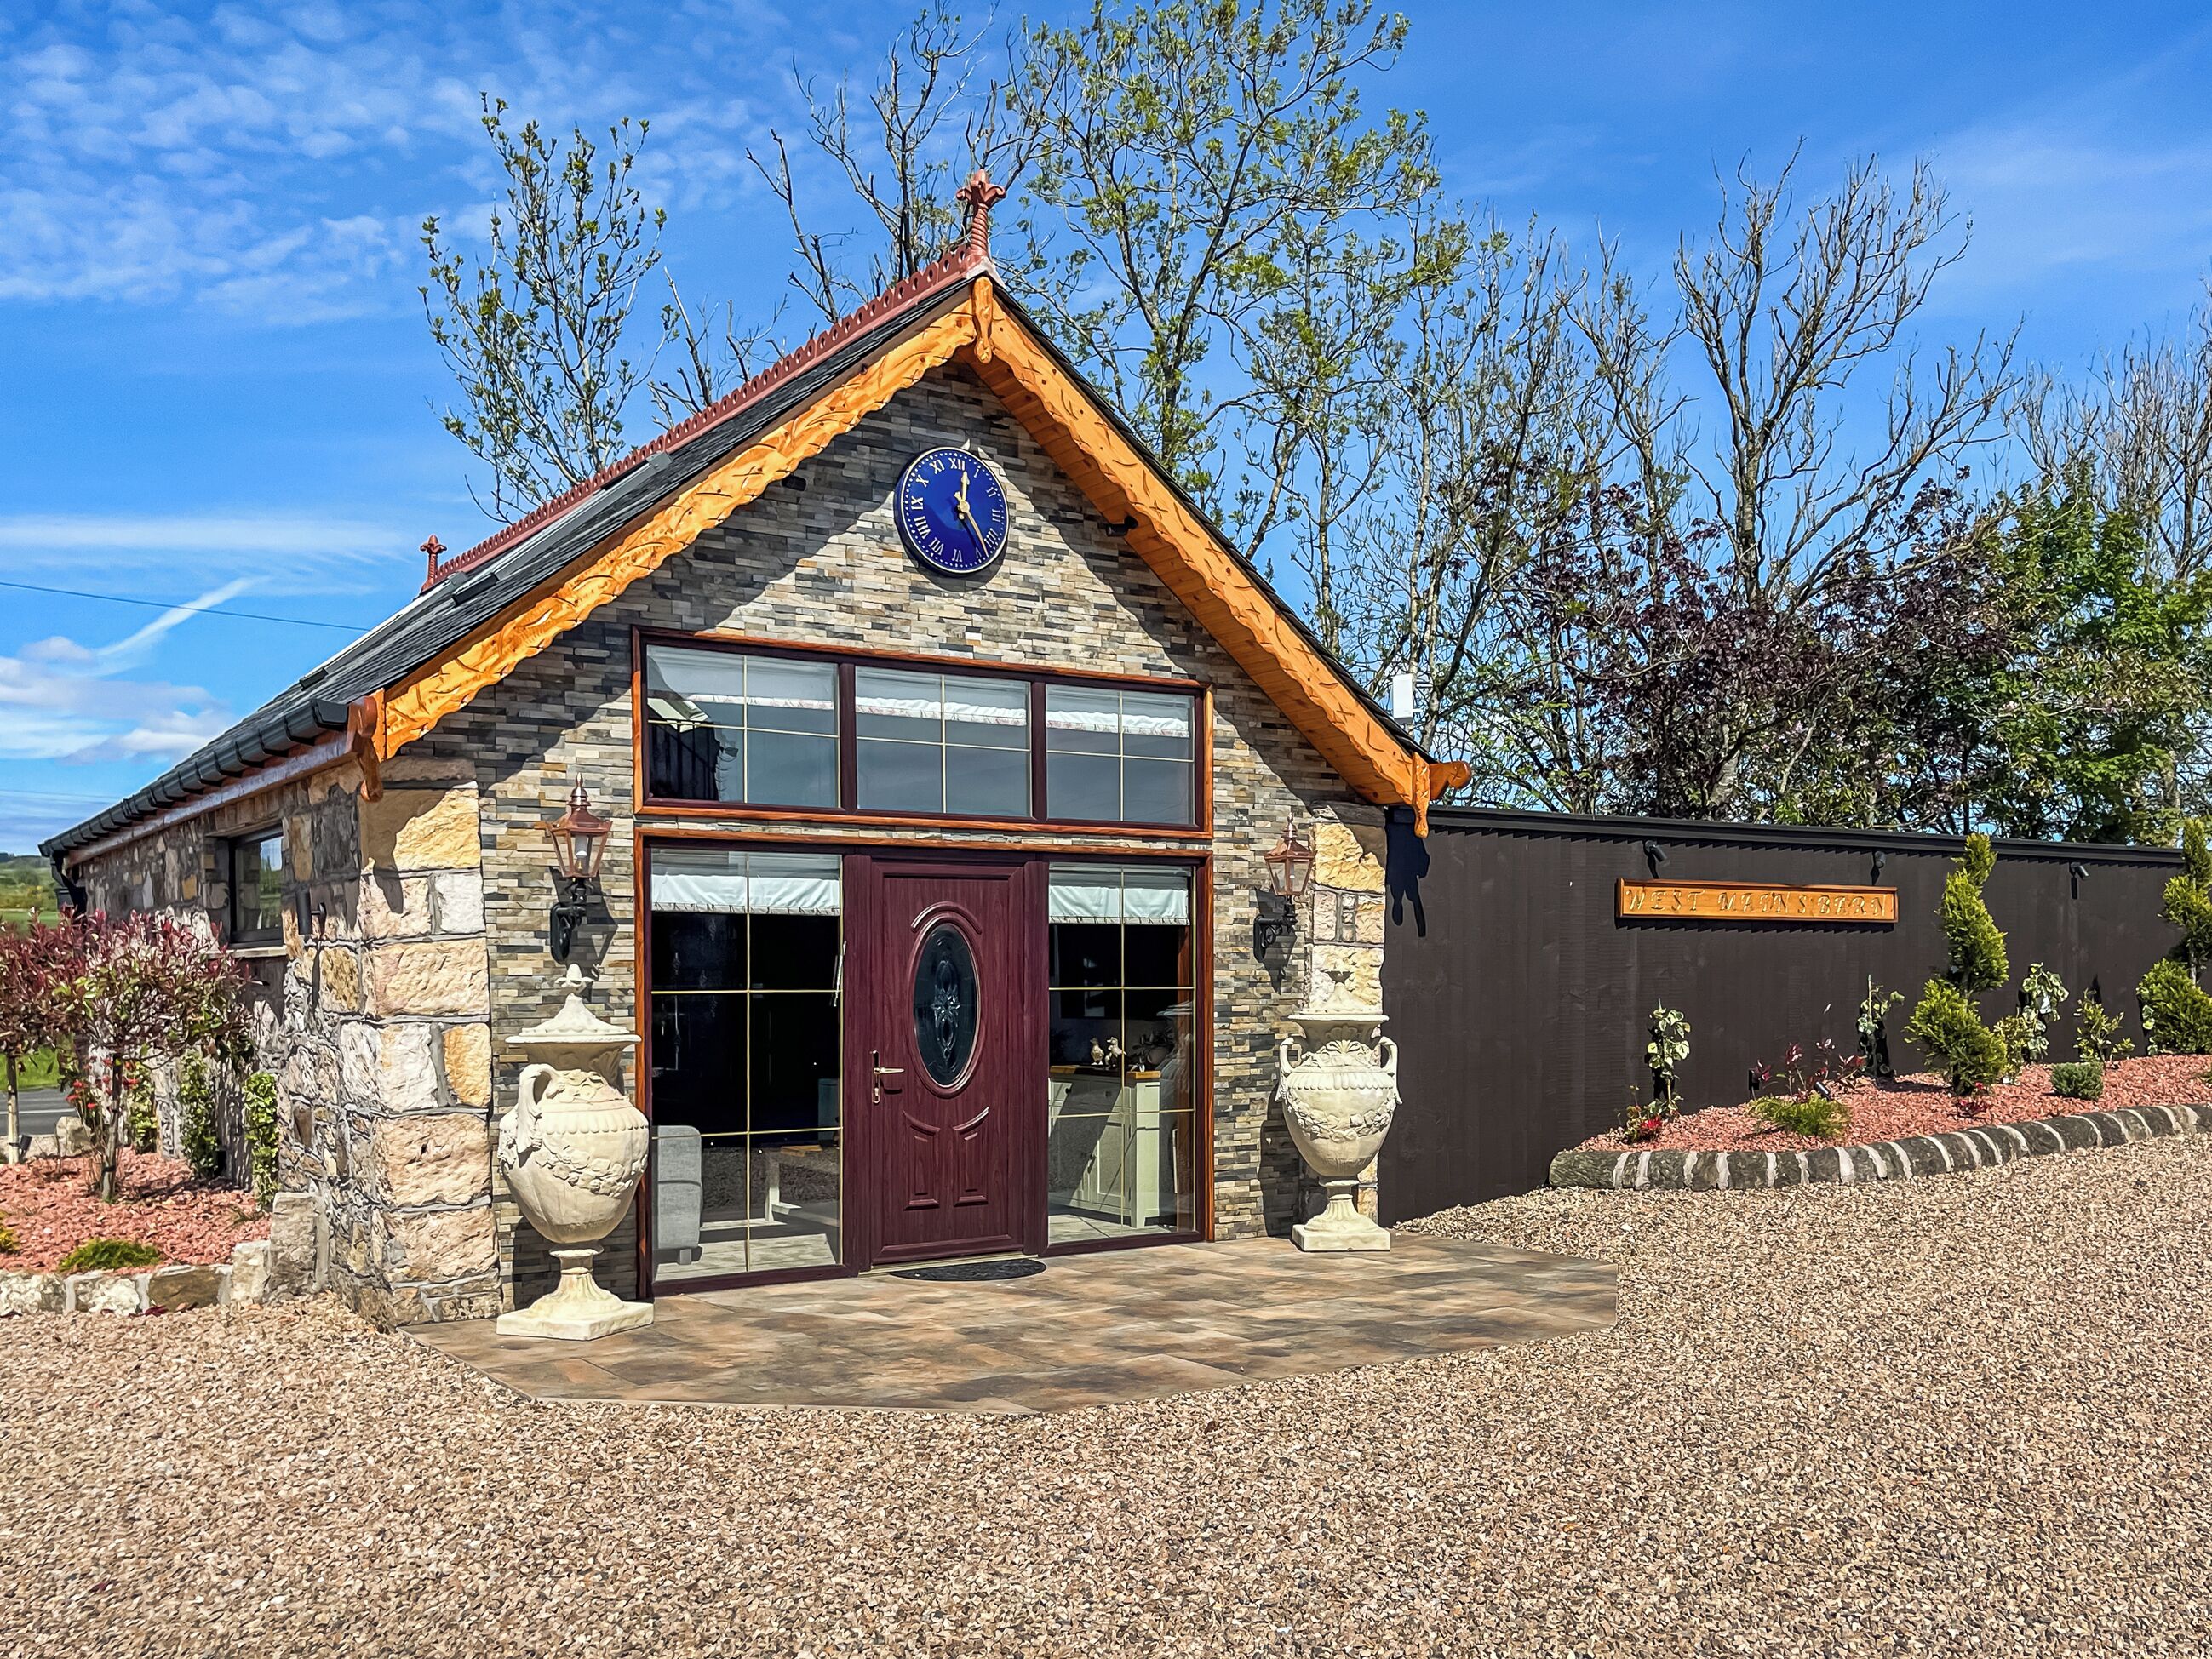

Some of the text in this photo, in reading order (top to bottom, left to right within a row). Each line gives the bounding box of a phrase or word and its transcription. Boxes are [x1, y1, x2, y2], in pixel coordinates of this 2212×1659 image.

[929, 459, 945, 474] XI
[948, 457, 966, 471] XII
[915, 474, 929, 487] X
[985, 486, 997, 497] II
[911, 495, 924, 510] IX
[992, 508, 1001, 523] III
[914, 516, 931, 539] VIII
[984, 528, 999, 548] IIII
[928, 537, 944, 555] VII
[952, 548, 962, 562] VI
[1625, 888, 1705, 912] WEST
[1817, 895, 1887, 916] BARN
